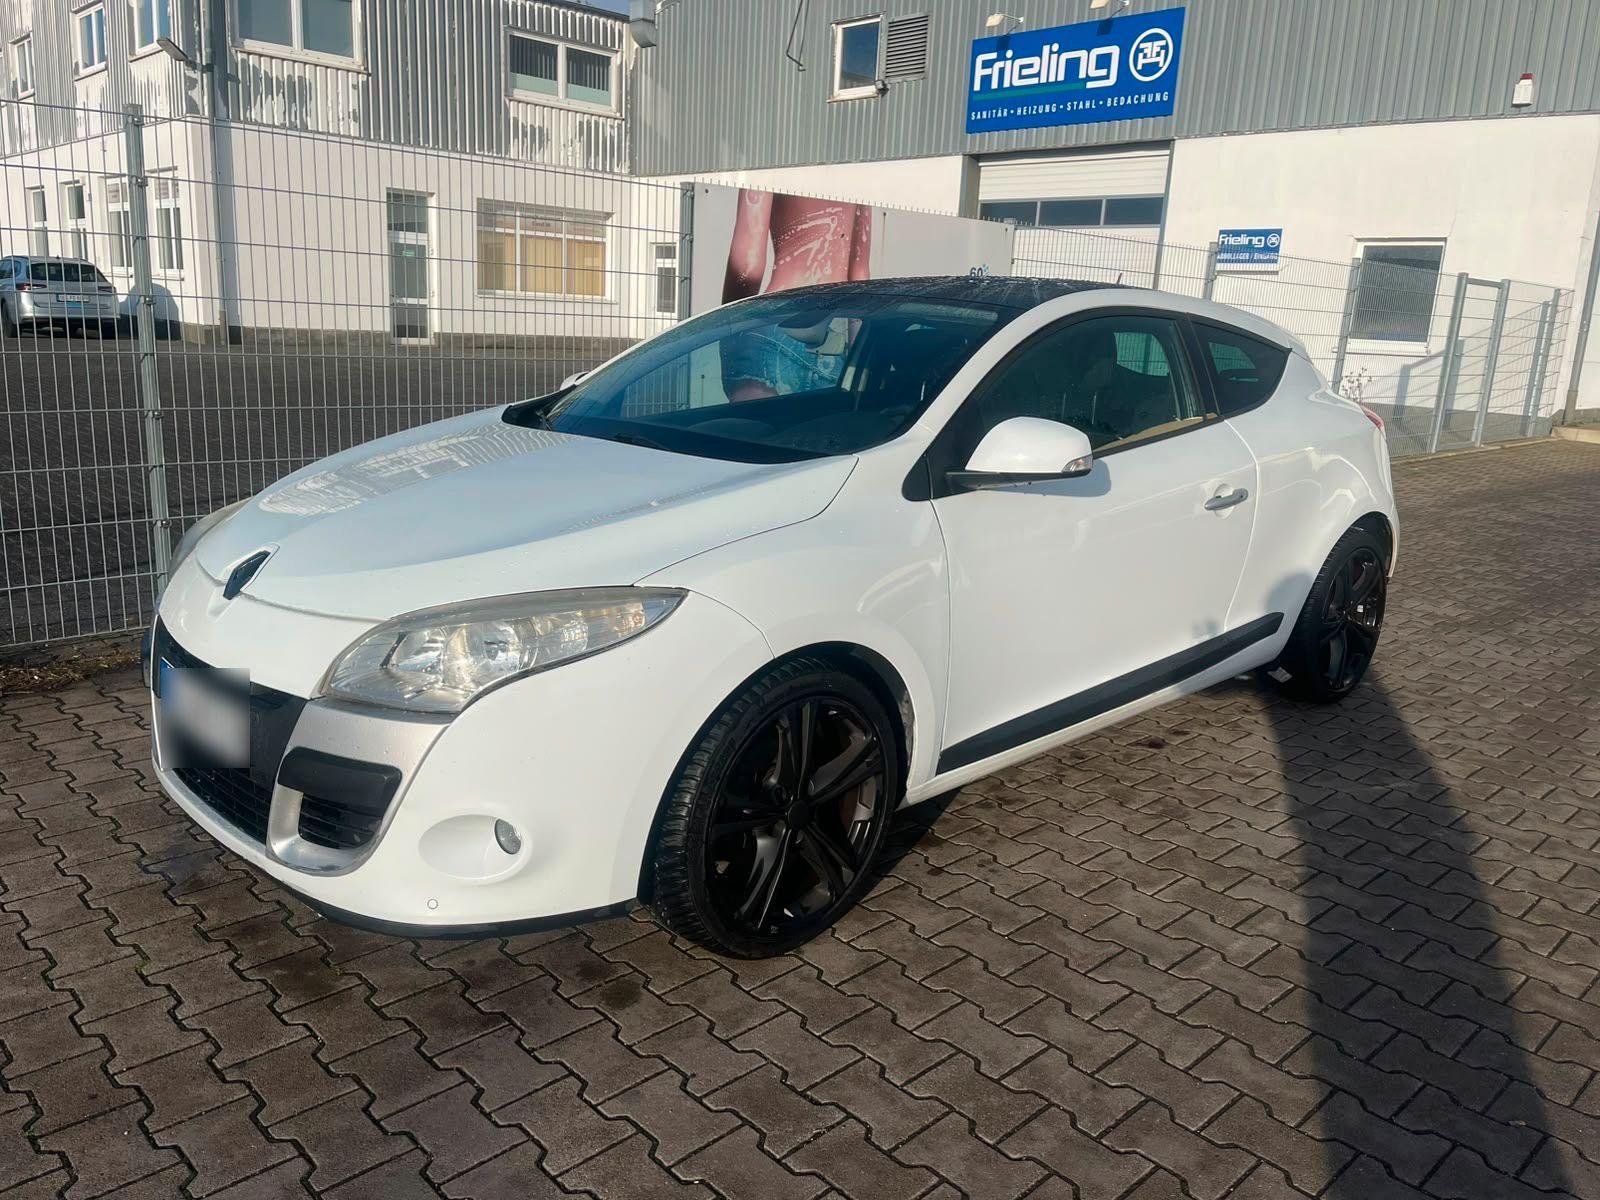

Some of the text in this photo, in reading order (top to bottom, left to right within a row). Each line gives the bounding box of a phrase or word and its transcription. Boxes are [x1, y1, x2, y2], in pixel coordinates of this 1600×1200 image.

[973, 42, 1120, 91] Frieling
[970, 91, 1169, 121] SANITÄR HEIZUNG STAHL BEDACHUNG
[1218, 233, 1265, 247] Frieling
